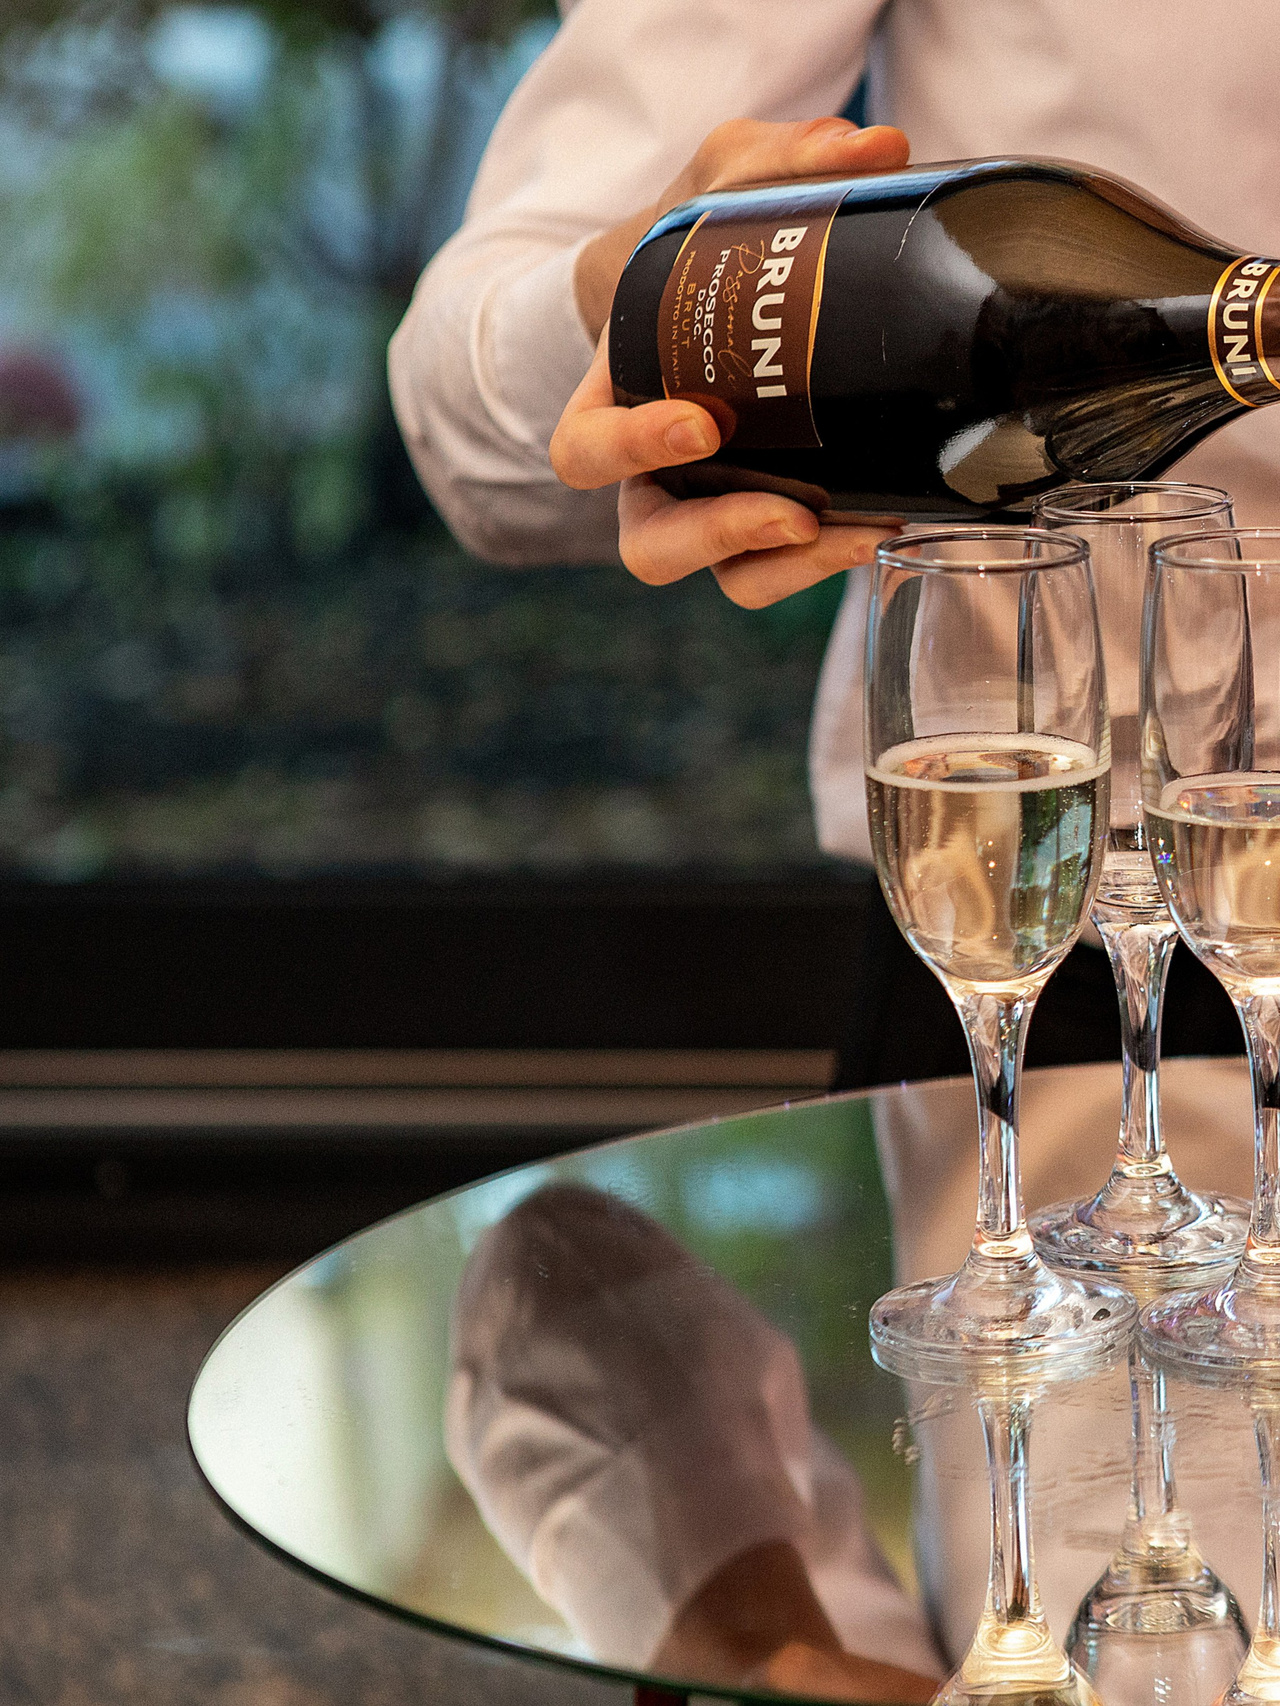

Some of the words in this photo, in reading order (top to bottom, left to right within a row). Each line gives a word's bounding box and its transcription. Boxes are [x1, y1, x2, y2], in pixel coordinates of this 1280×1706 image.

[672, 251, 696, 321] PRODOTTO
[682, 282, 696, 348] BRUT
[693, 289, 706, 340] D.O.C.
[703, 249, 731, 383] PROSECCO
[751, 226, 808, 398] BRUNI
[1222, 263, 1271, 376] BRUNI
[672, 325, 678, 339] IN
[672, 345, 680, 388] ITALIA
